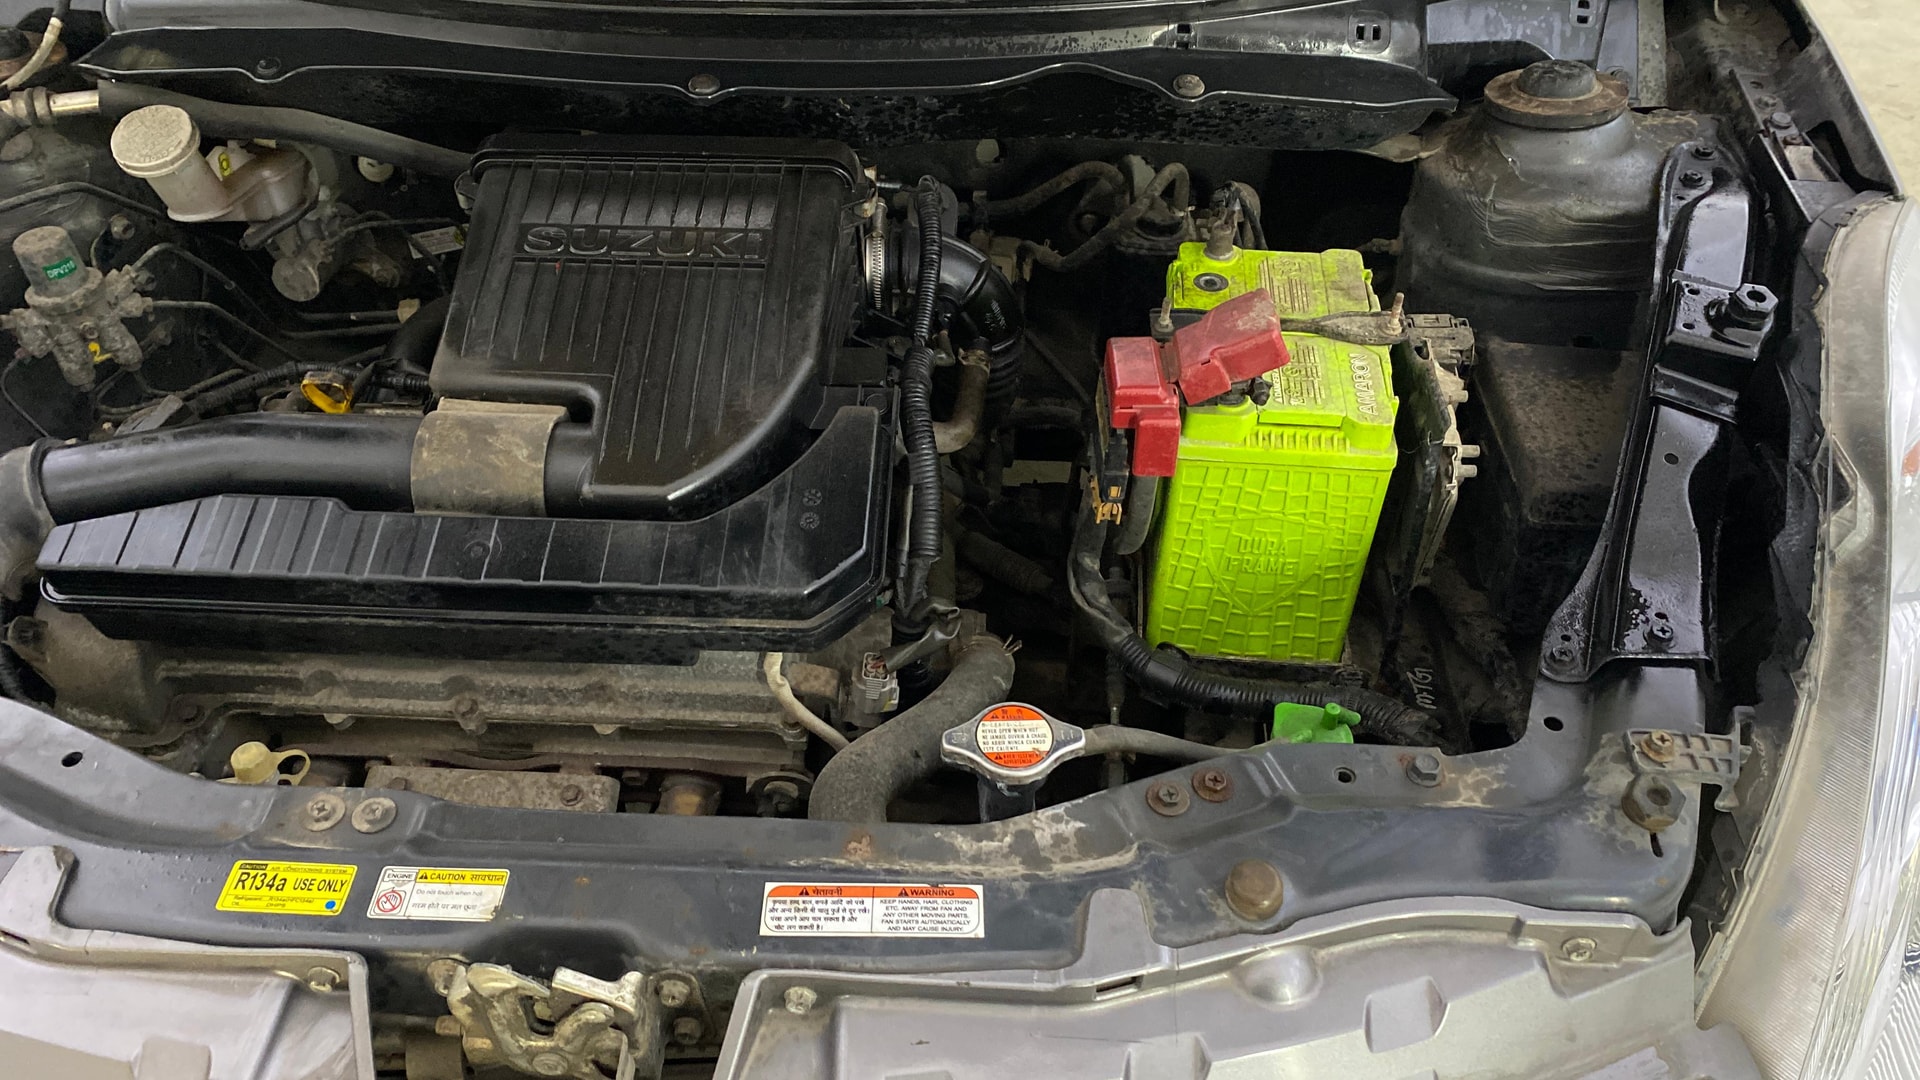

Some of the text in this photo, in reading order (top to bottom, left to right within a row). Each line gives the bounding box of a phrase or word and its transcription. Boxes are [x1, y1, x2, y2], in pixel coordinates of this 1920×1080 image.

[523, 226, 763, 259] SUZUKI
[1348, 353, 1379, 415] AMARON
[1239, 537, 1288, 555] DURA
[1225, 556, 1299, 575] FRAME
[234, 872, 348, 892] R134a USE ONLY
[430, 872, 466, 881] CAUTION
[812, 886, 842, 895] चेतावनी
